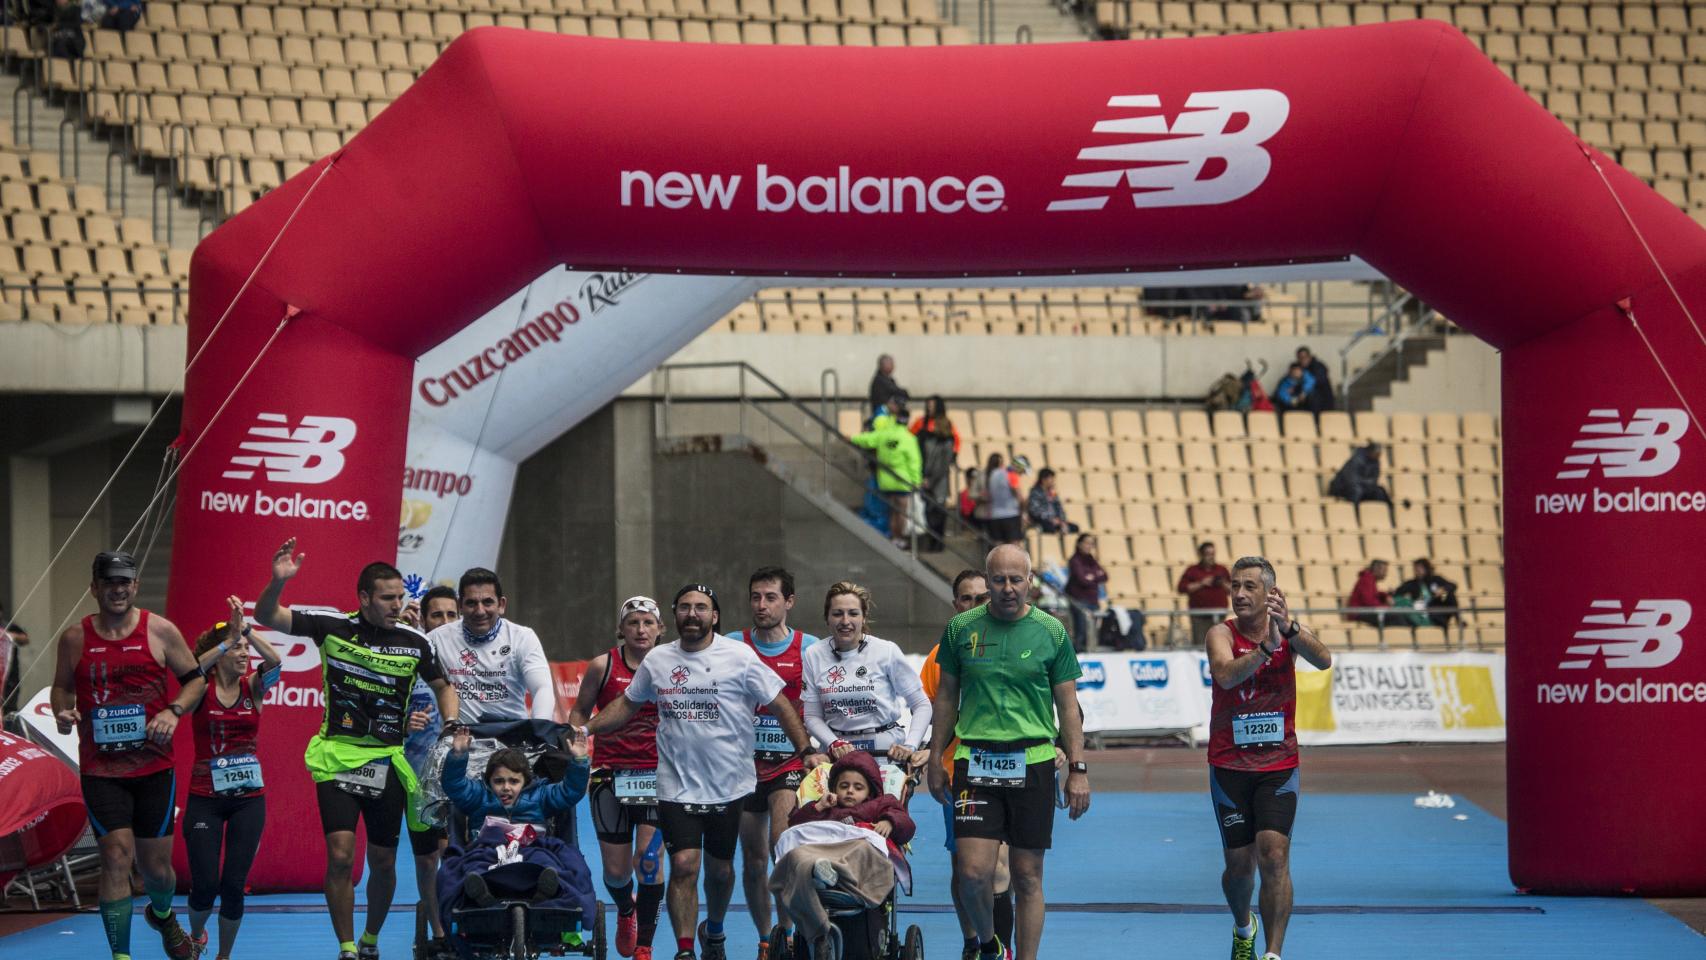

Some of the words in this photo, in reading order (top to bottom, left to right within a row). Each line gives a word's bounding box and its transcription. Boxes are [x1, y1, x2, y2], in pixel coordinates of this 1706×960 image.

[620, 170, 741, 210] new
[756, 163, 1005, 213] balance
[418, 301, 580, 407] Cruzcampo
[201, 491, 249, 513] new
[254, 489, 368, 521] balance
[1536, 493, 1587, 514] new
[1334, 664, 1425, 691] RENAULT
[1538, 683, 1589, 704] new
[109, 707, 139, 717] ZURICH
[103, 722, 138, 735] 11893
[1244, 723, 1278, 735] 12320
[755, 732, 788, 744] 11888
[982, 759, 1016, 770] 11425
[223, 770, 254, 783] 12941
